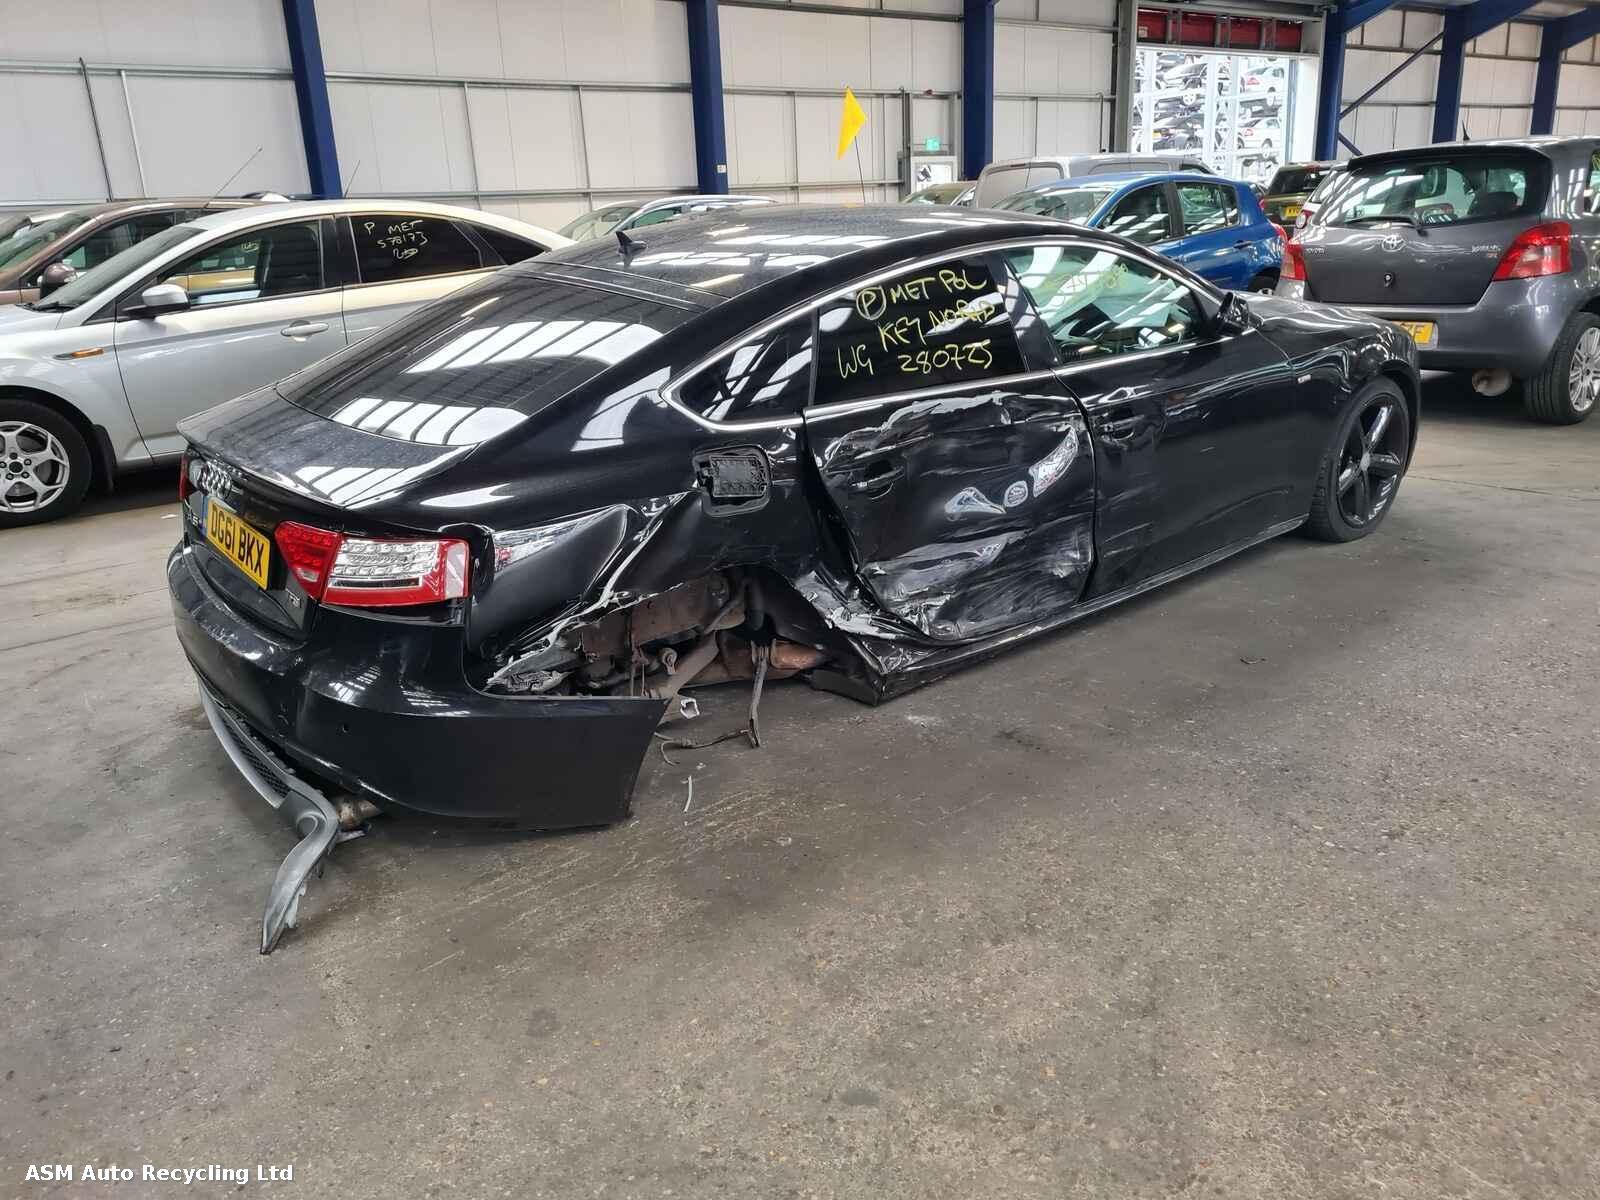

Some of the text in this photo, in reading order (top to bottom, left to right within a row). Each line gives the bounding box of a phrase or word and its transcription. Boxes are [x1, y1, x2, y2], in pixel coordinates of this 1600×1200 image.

[388, 219, 424, 234] MET
[890, 277, 936, 304] MET
[878, 316, 927, 352] KEY
[898, 338, 993, 374] 280725
[238, 528, 265, 578] BKX
